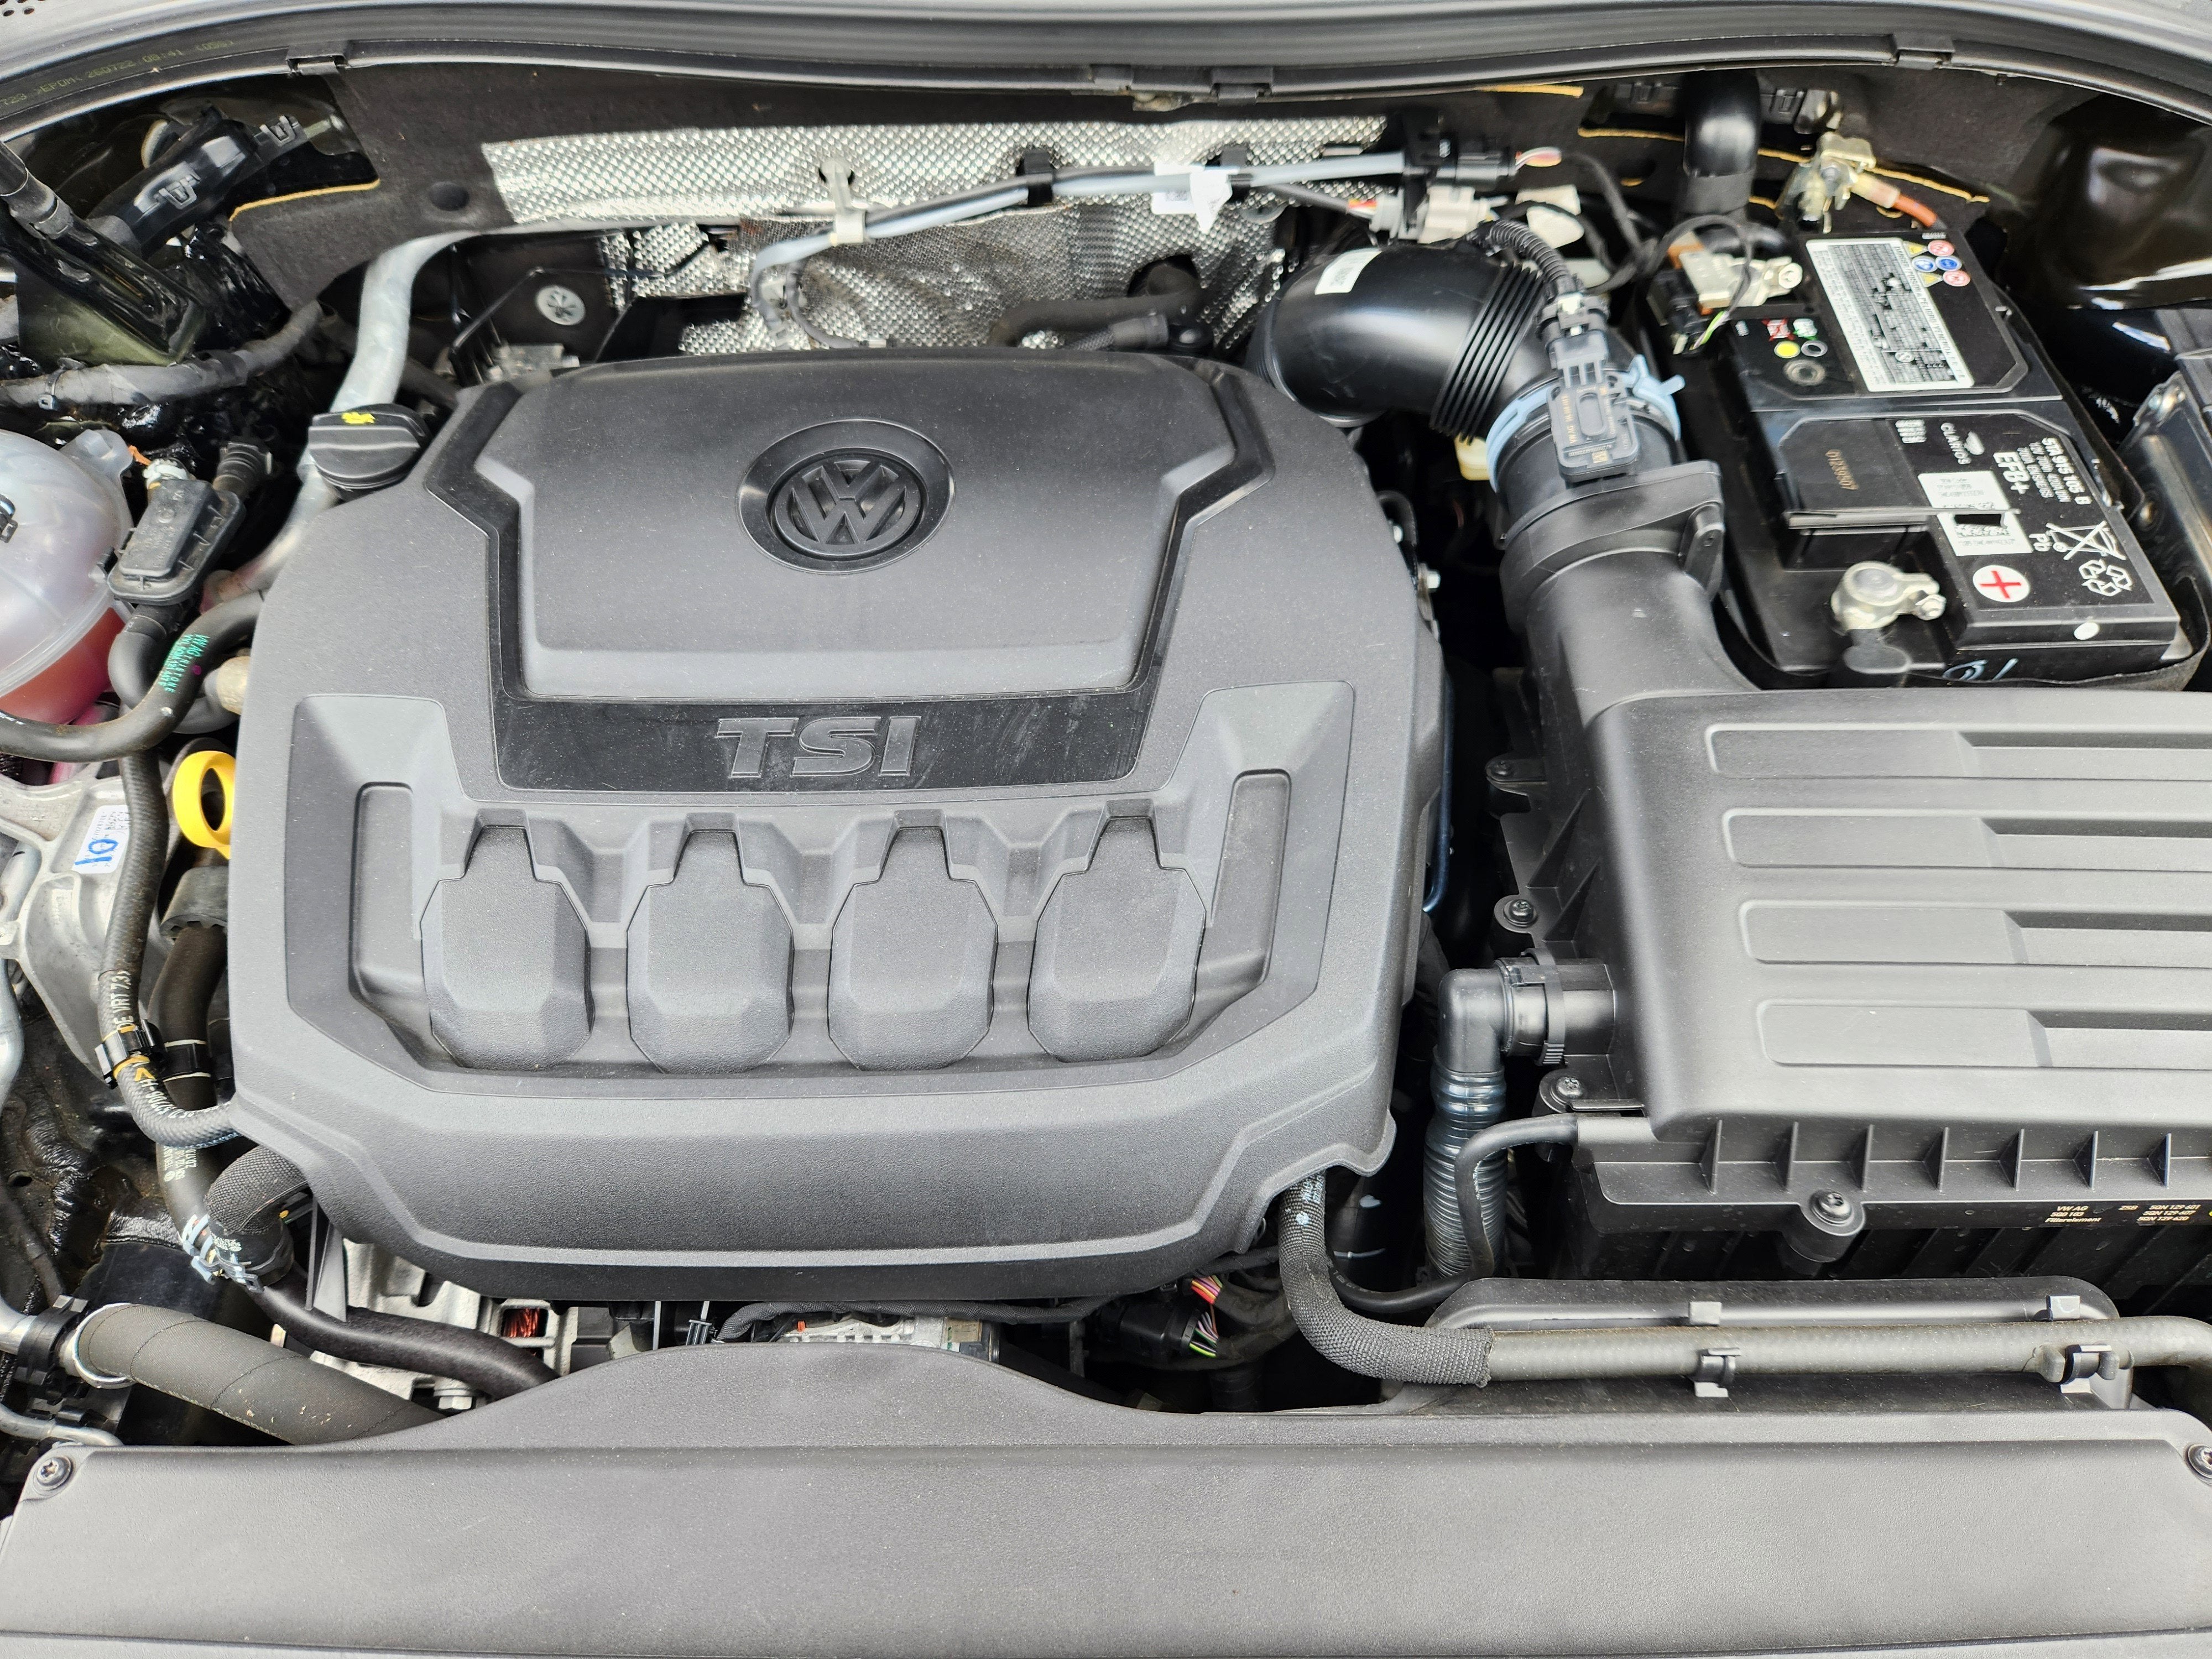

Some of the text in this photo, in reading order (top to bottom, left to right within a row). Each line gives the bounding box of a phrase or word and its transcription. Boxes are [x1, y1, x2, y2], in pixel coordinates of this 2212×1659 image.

[1940, 422, 1971, 465] CLARIOS
[1993, 451, 2030, 494] EFB+
[2029, 533, 2052, 552] Pb
[716, 716, 921, 778] TSI
[111, 994, 130, 1013] VRT
